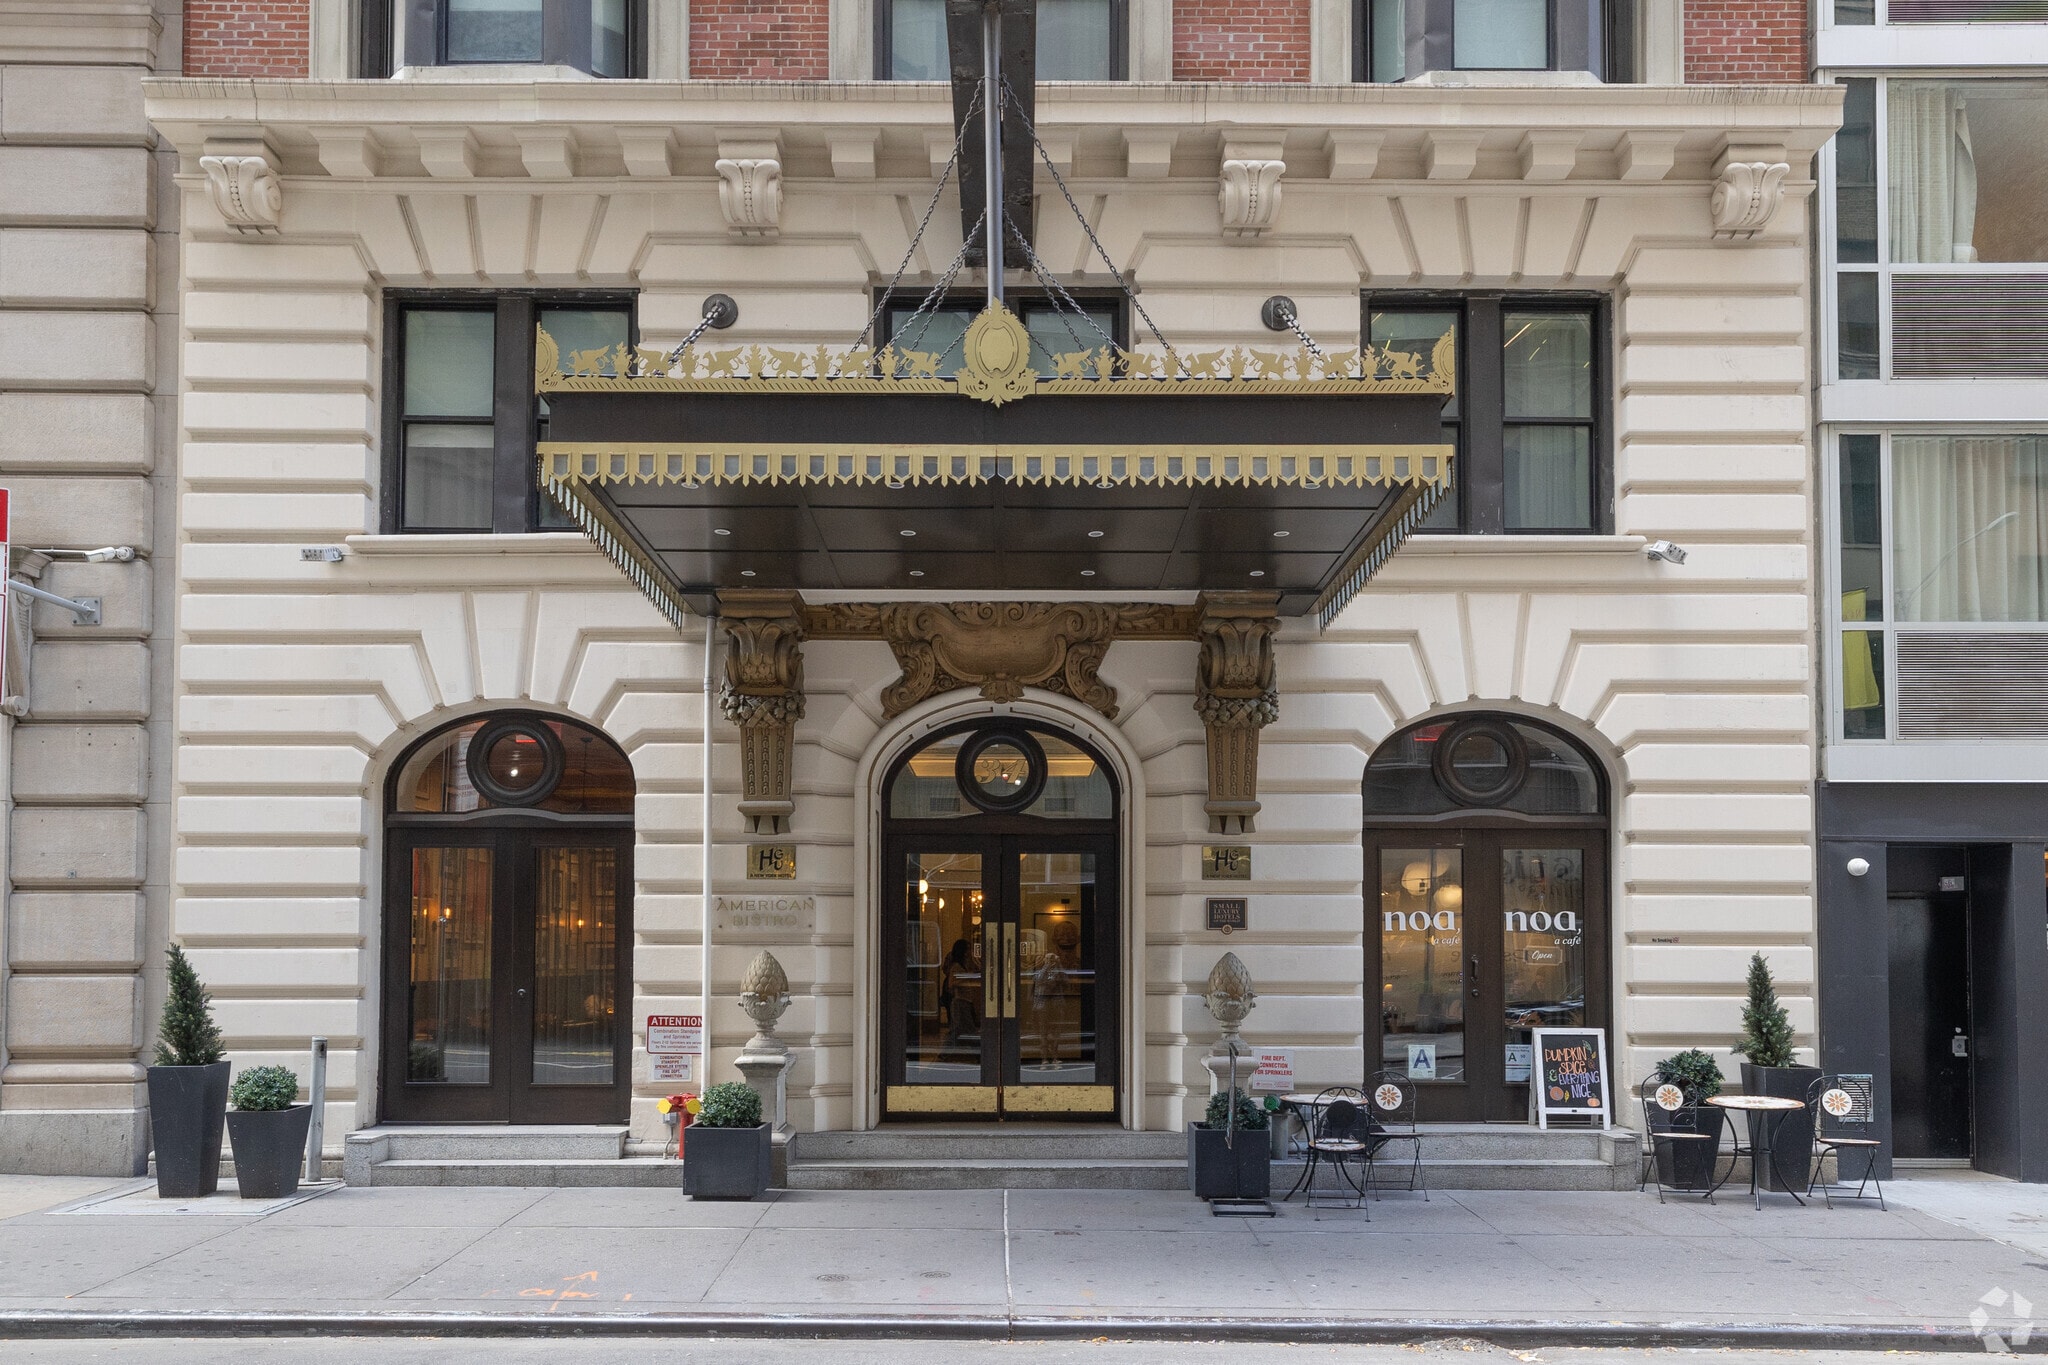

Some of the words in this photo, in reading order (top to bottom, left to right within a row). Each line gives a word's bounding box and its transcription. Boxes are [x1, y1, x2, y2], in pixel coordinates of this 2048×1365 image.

[976, 759, 1026, 784] 34
[717, 900, 814, 911] AMERICAN
[733, 914, 797, 926] BISTRO
[1562, 936, 1582, 946] café
[1532, 950, 1552, 960] Open
[651, 1016, 702, 1026] ATTENTION
[1413, 1049, 1431, 1068] A
[1508, 1053, 1517, 1061] A
[1544, 1046, 1587, 1062] PUMPKIN
[1550, 1069, 1557, 1082] &
[1559, 1070, 1600, 1085] EVERYTHING
[1571, 1084, 1592, 1098] NICE
